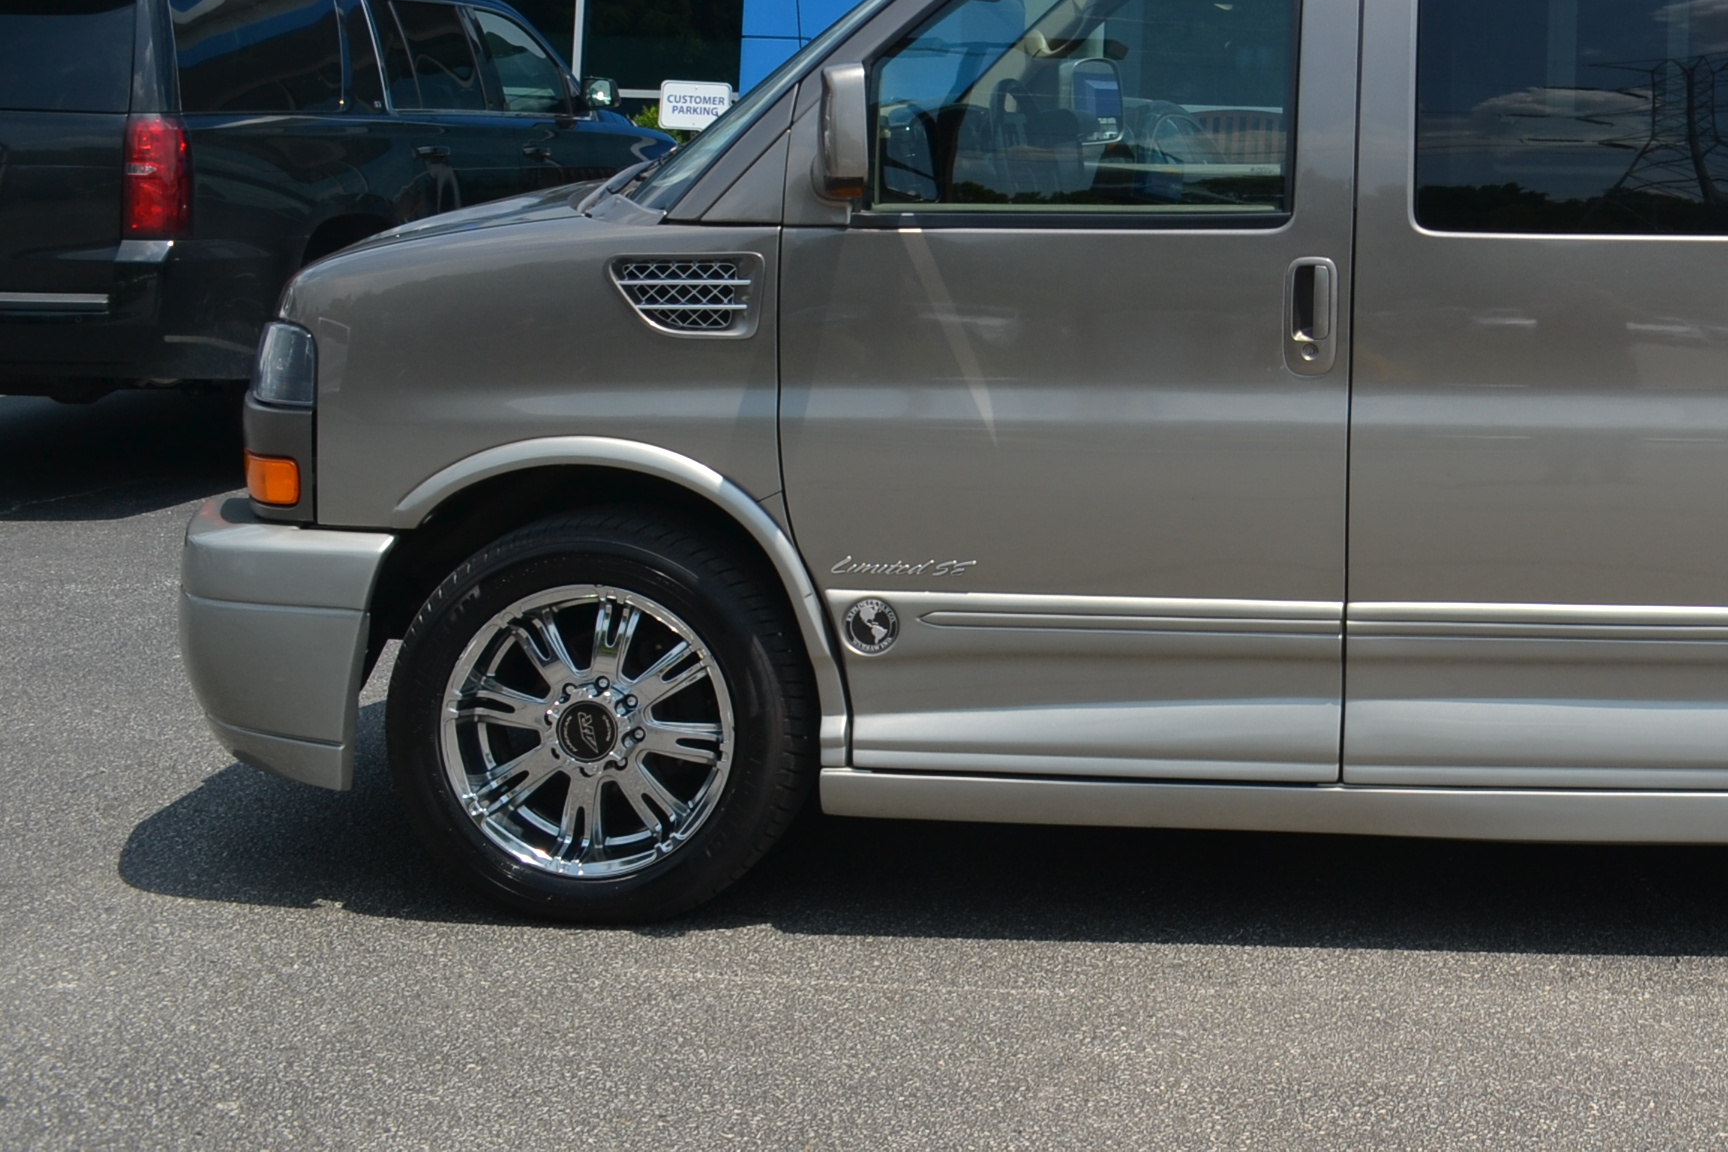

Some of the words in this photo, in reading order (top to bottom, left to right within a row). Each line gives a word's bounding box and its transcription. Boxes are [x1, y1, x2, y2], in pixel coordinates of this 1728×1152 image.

[666, 94, 725, 106] CUSTOMER
[671, 105, 719, 117] PARKING
[830, 555, 935, 576] Limited
[932, 559, 977, 576] SE
